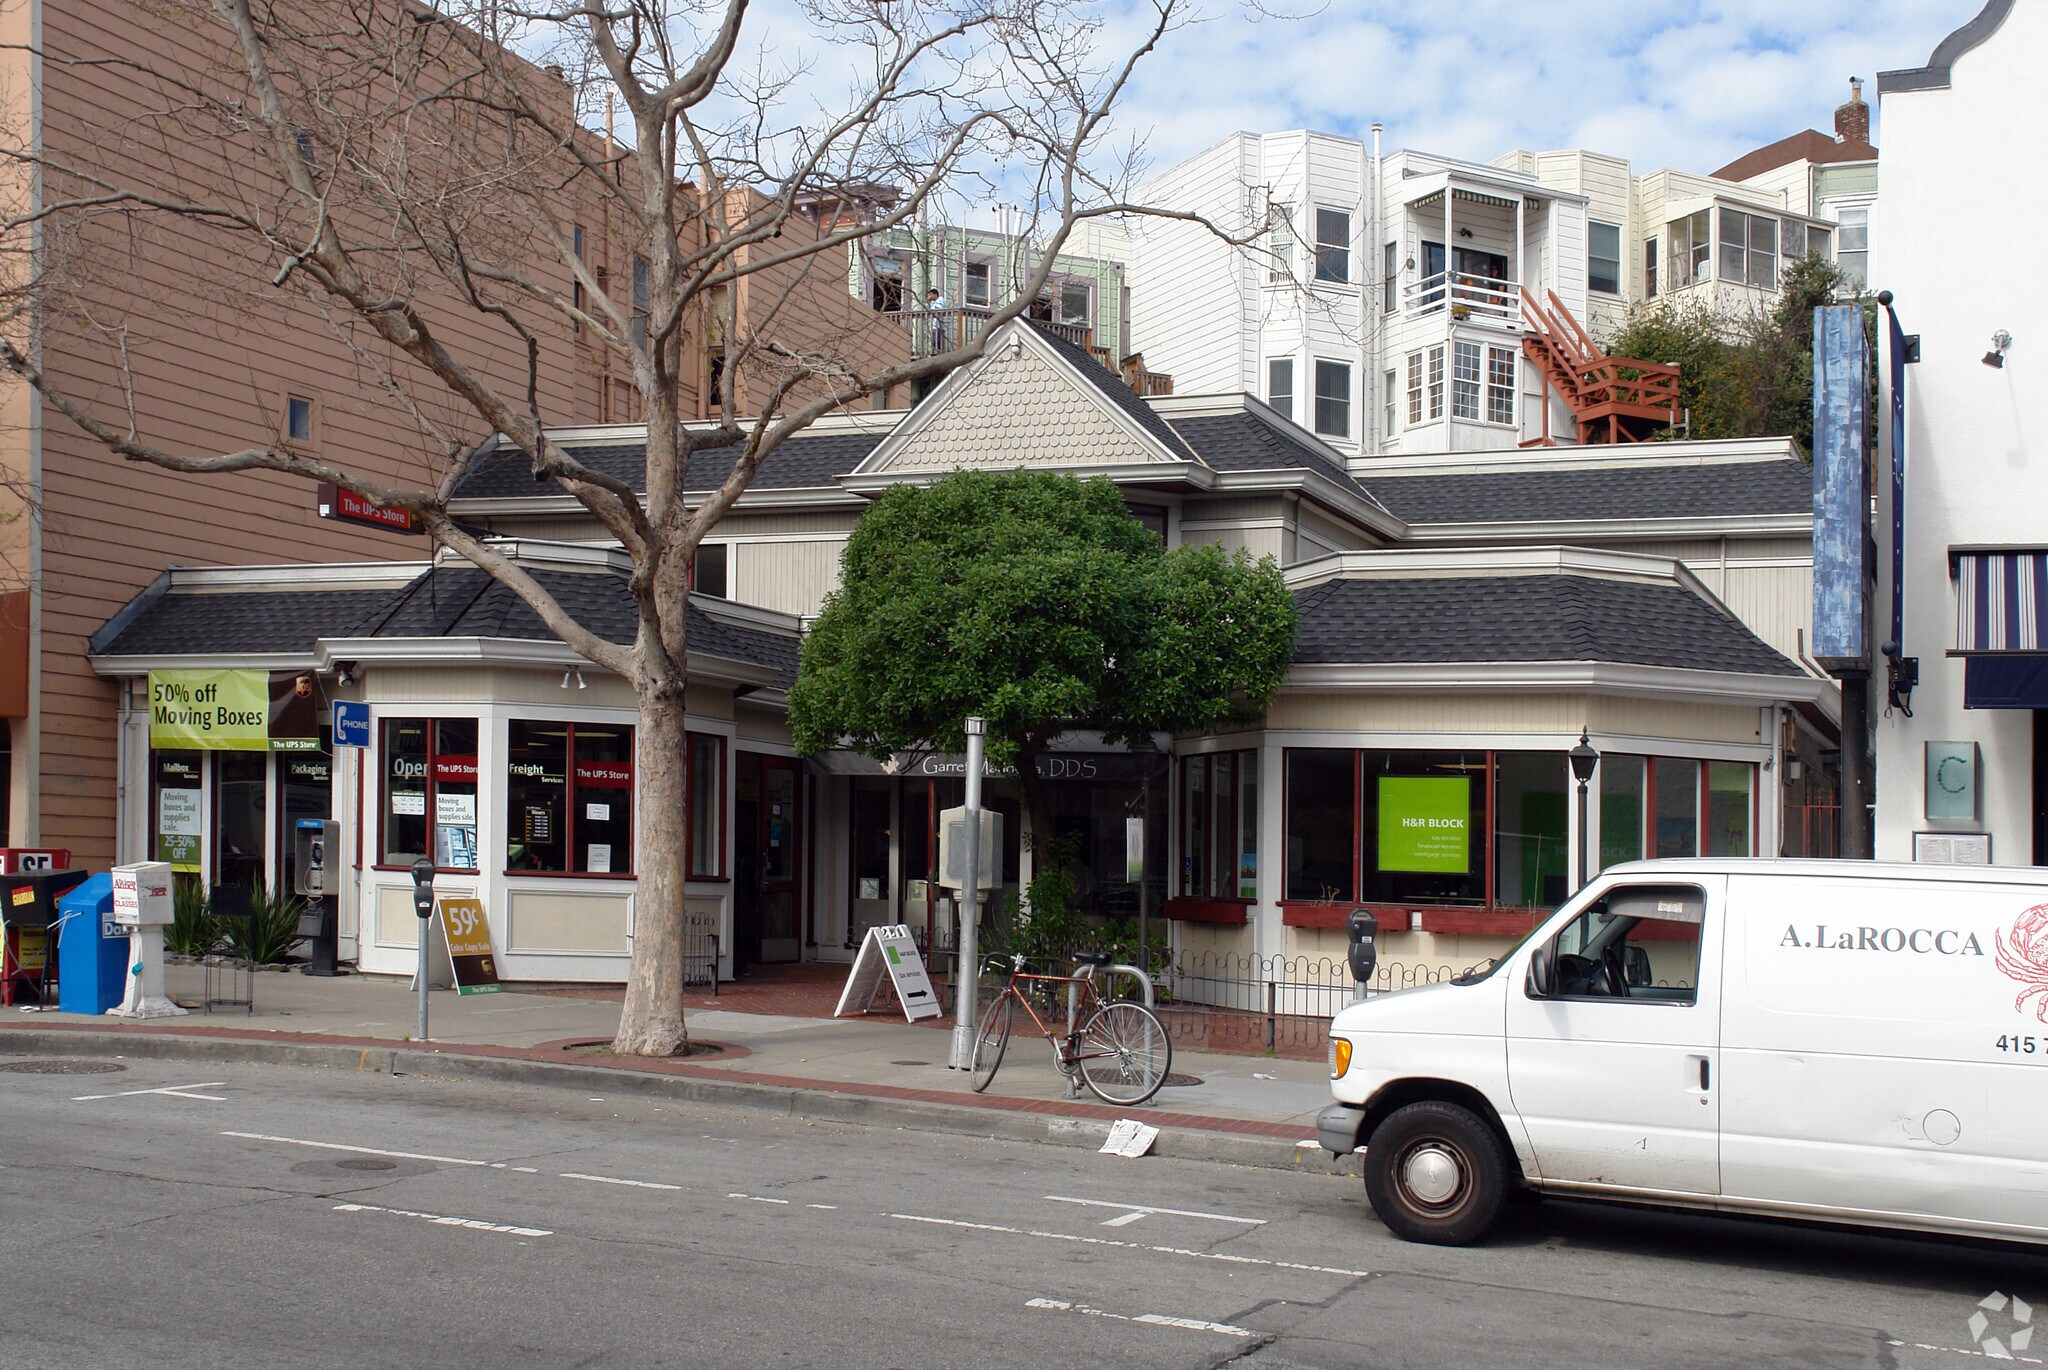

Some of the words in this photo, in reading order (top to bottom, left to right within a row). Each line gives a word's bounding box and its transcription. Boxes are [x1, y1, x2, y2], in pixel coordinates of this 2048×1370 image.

[344, 498, 360, 513] The
[383, 509, 405, 523] Store
[155, 684, 189, 702] 50%
[195, 684, 217, 702] off
[155, 706, 212, 730] Moving
[217, 706, 263, 725] Boxes
[342, 720, 369, 730] PHONE
[300, 741, 315, 749] Store
[163, 763, 190, 772] Mailbox
[291, 764, 327, 776] Packaging
[437, 764, 449, 773] The
[450, 765, 462, 773] UPS
[509, 763, 544, 776] Freight
[1050, 758, 1097, 779] DDS
[577, 768, 592, 778] The
[592, 770, 607, 779] UPS
[609, 770, 629, 780] Store
[1937, 756, 1967, 793] C
[164, 792, 188, 804] Moving
[439, 797, 459, 806] Moving
[164, 803, 182, 812] boxes
[183, 803, 196, 812] and
[164, 812, 190, 824] supplies
[439, 813, 460, 822] supplies
[1402, 818, 1425, 828] H&R
[1428, 818, 1464, 829] BLOCK
[163, 822, 179, 832] sale.
[172, 847, 187, 860] OFF
[449, 907, 479, 936] 59¢
[1779, 924, 1985, 956] A.LaROCCA
[465, 943, 478, 953] Copy
[479, 942, 490, 951] Sale
[1996, 1034, 2036, 1054] 415
